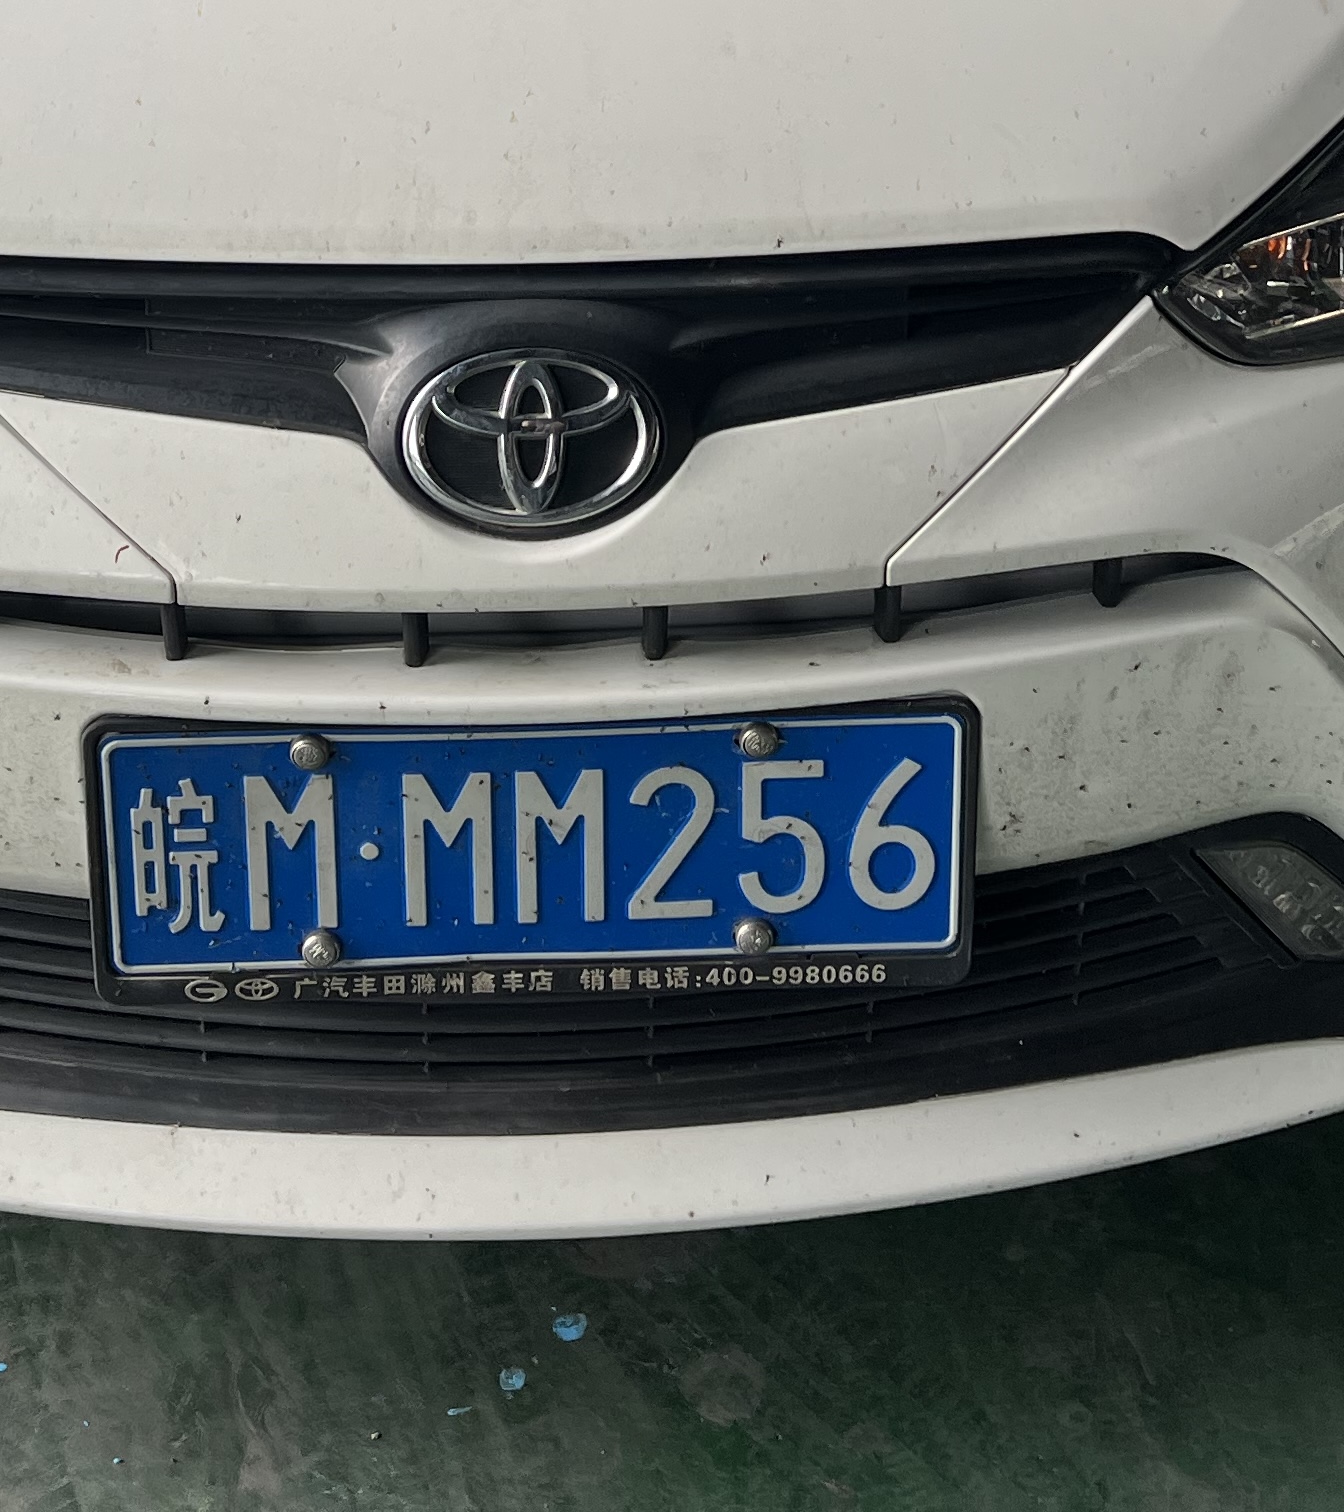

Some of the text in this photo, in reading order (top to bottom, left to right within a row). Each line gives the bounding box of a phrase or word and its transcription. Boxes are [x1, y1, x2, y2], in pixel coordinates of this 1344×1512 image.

[128, 755, 938, 936] 皖M·MM256
[292, 969, 555, 1000] 广汽丰田滁州鑫丰店
